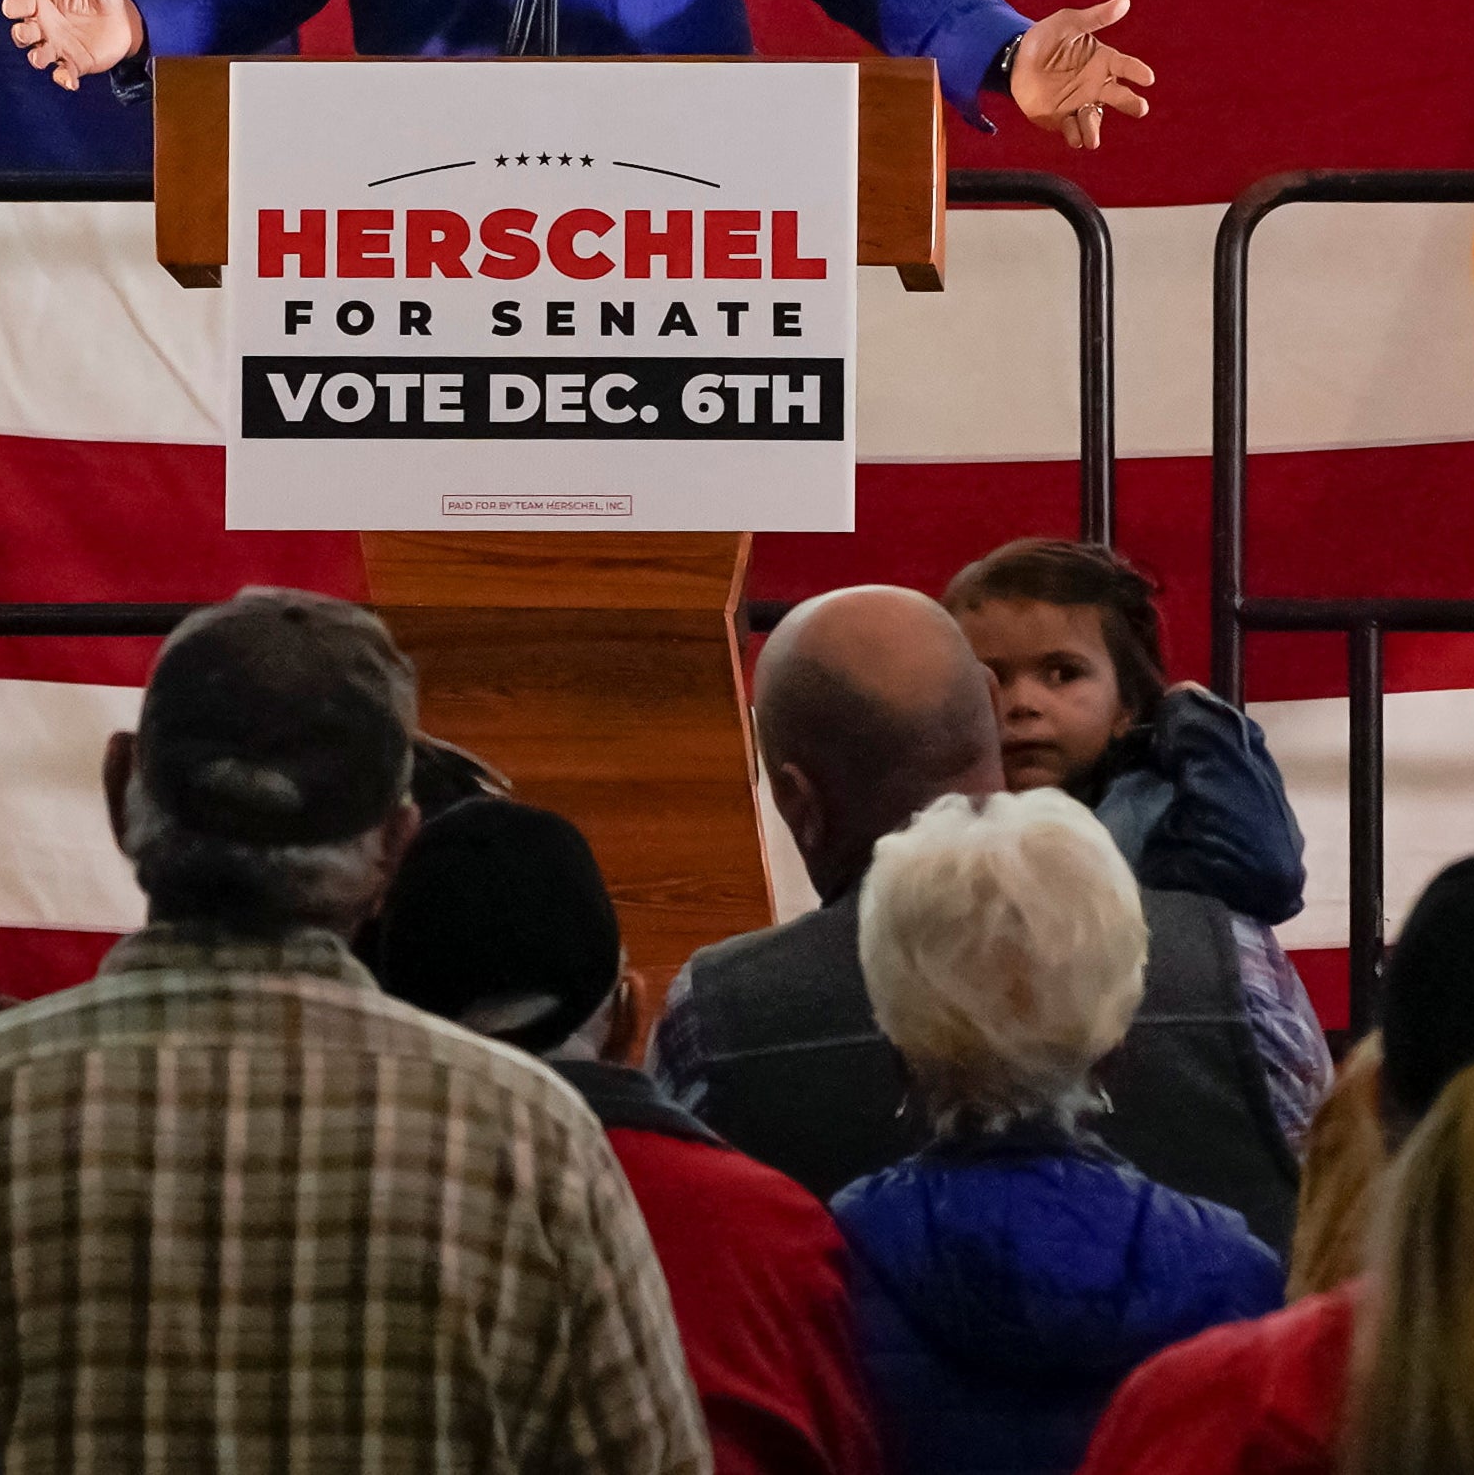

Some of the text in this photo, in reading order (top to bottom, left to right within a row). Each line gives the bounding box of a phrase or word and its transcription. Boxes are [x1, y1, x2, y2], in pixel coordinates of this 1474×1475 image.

[258, 208, 827, 280] HERSCHEL
[284, 300, 802, 337] FOR SENATE
[265, 372, 822, 424] VOTE DEC. 6TH
[448, 501, 626, 512] PAID FOR BY TEAM HERSCHEL, INC.
